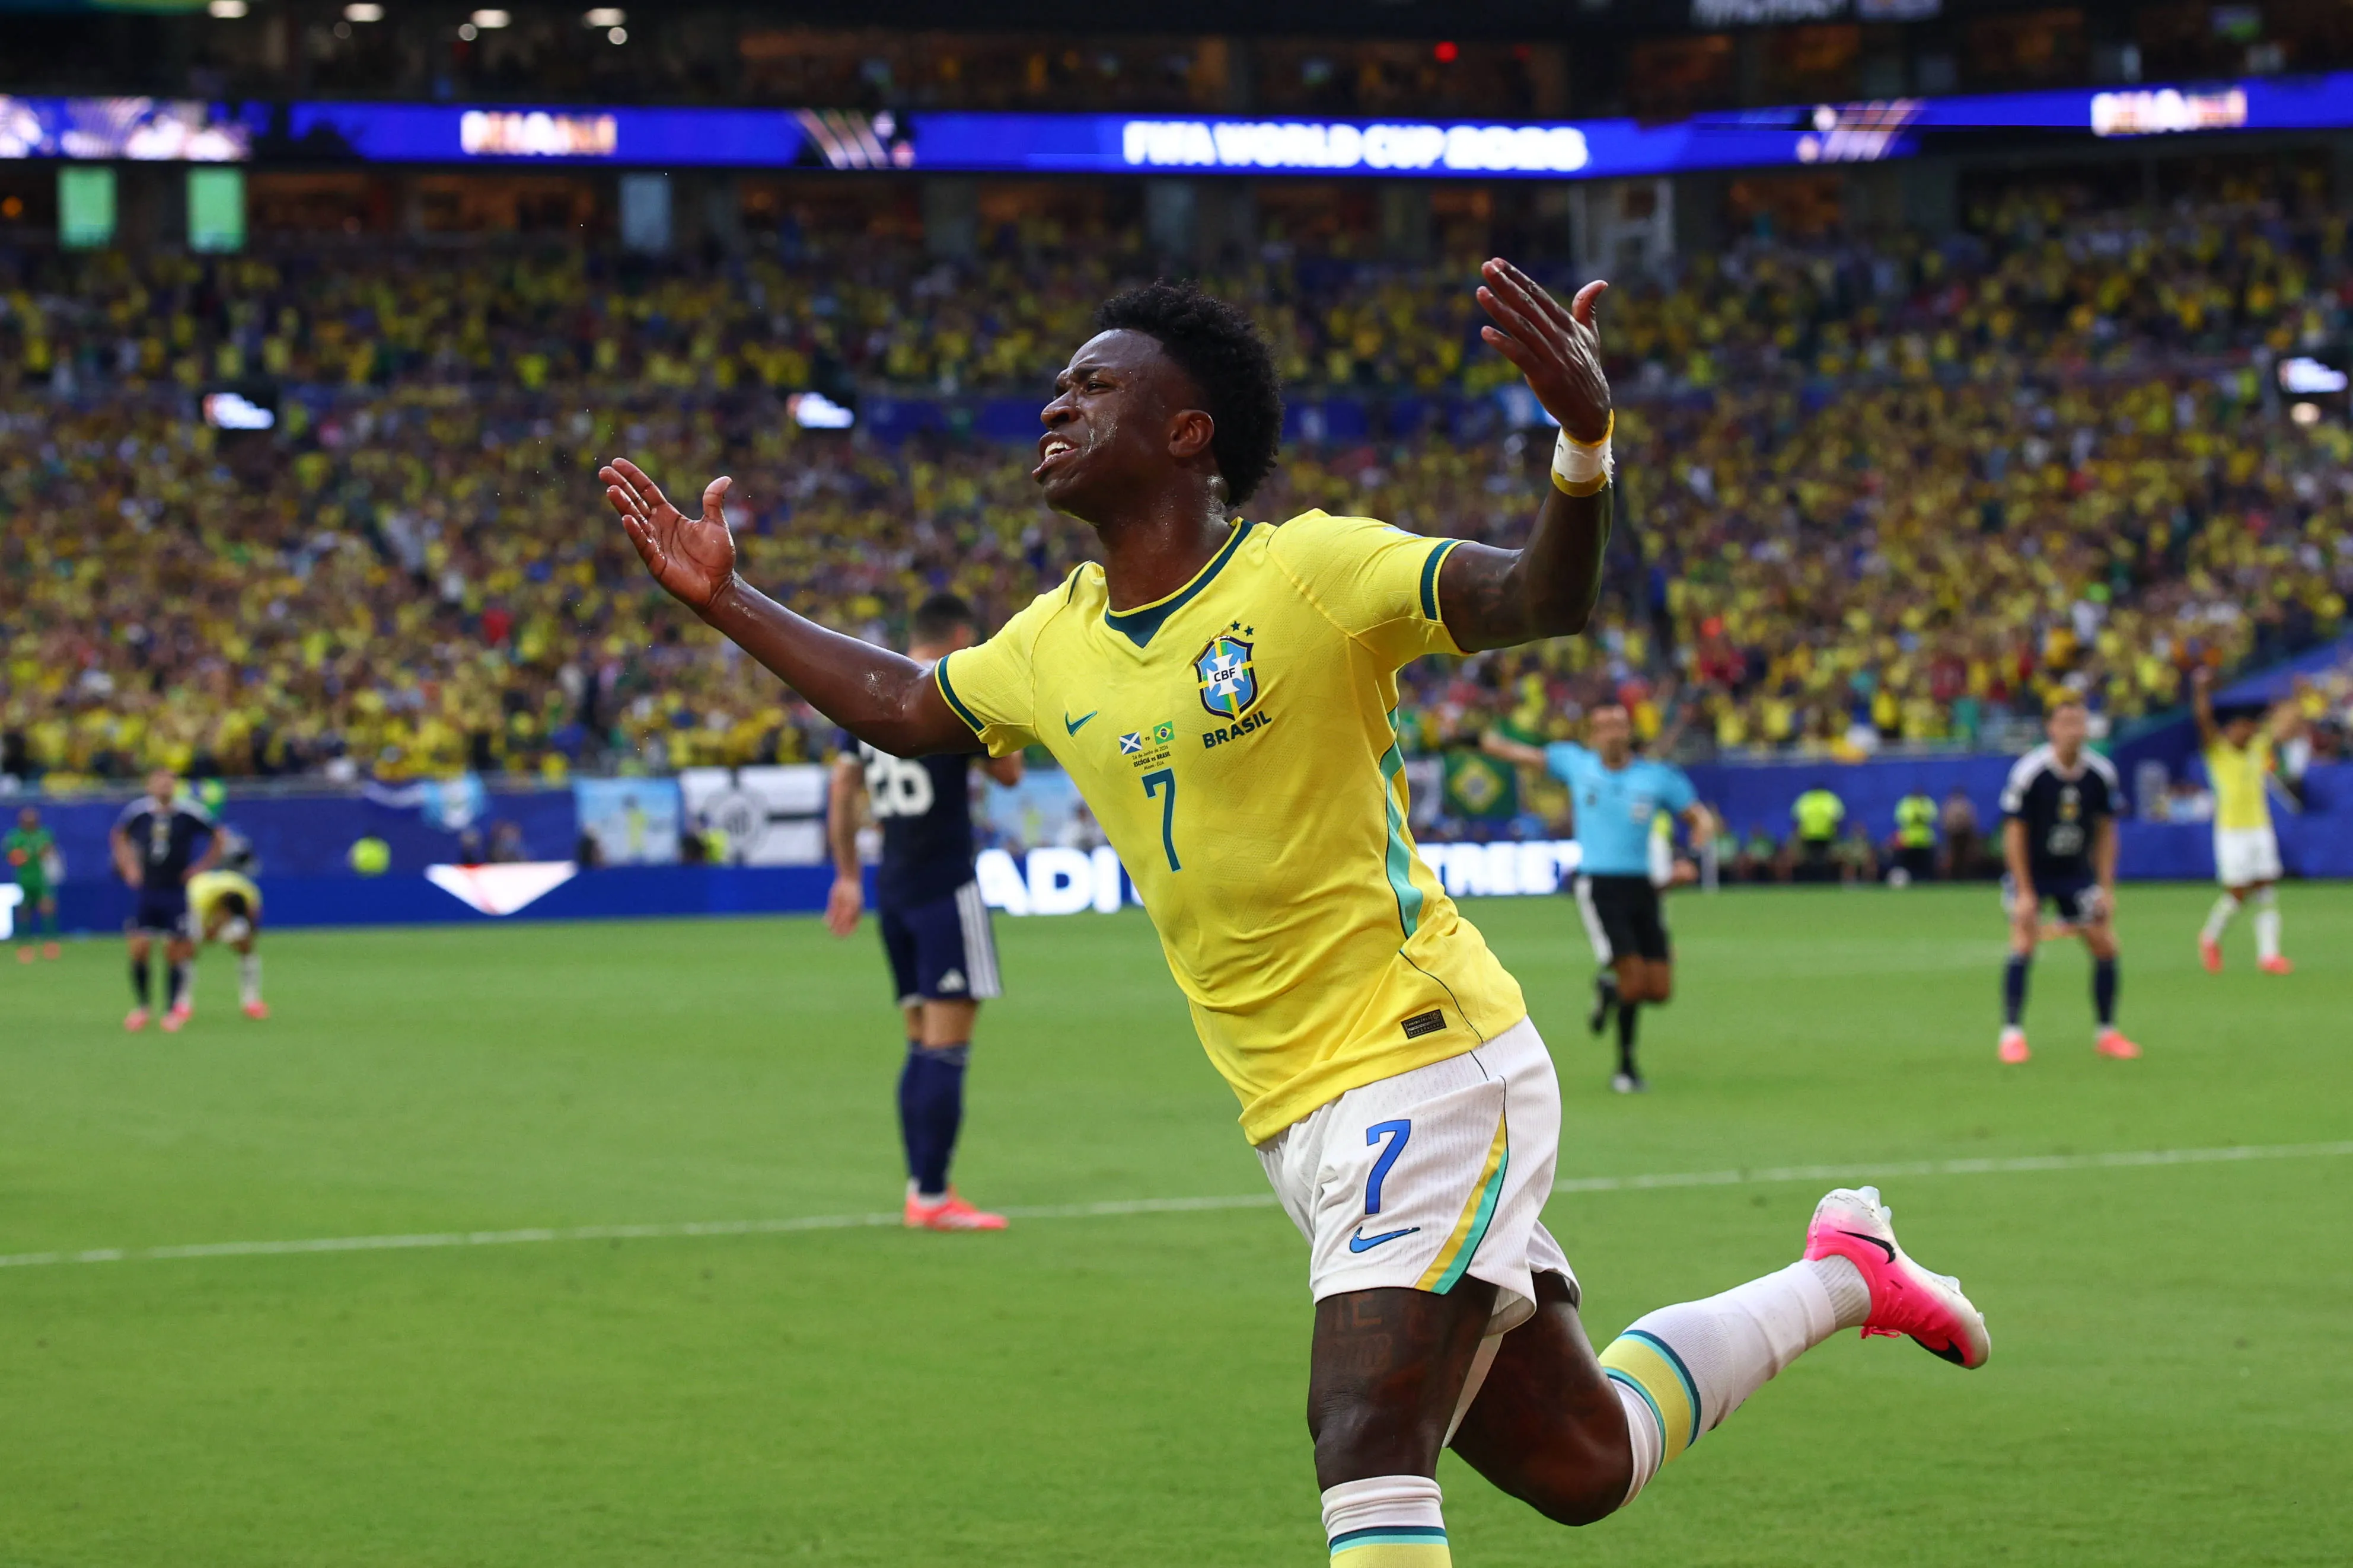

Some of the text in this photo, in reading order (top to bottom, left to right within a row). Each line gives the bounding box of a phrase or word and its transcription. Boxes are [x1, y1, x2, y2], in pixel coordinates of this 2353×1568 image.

[1214, 668, 1235, 682] CBF
[1203, 711, 1272, 749] BRASIL
[1157, 751, 1171, 759] BRASIL
[1141, 767, 1182, 873] 7
[1365, 1119, 1411, 1215] 7
